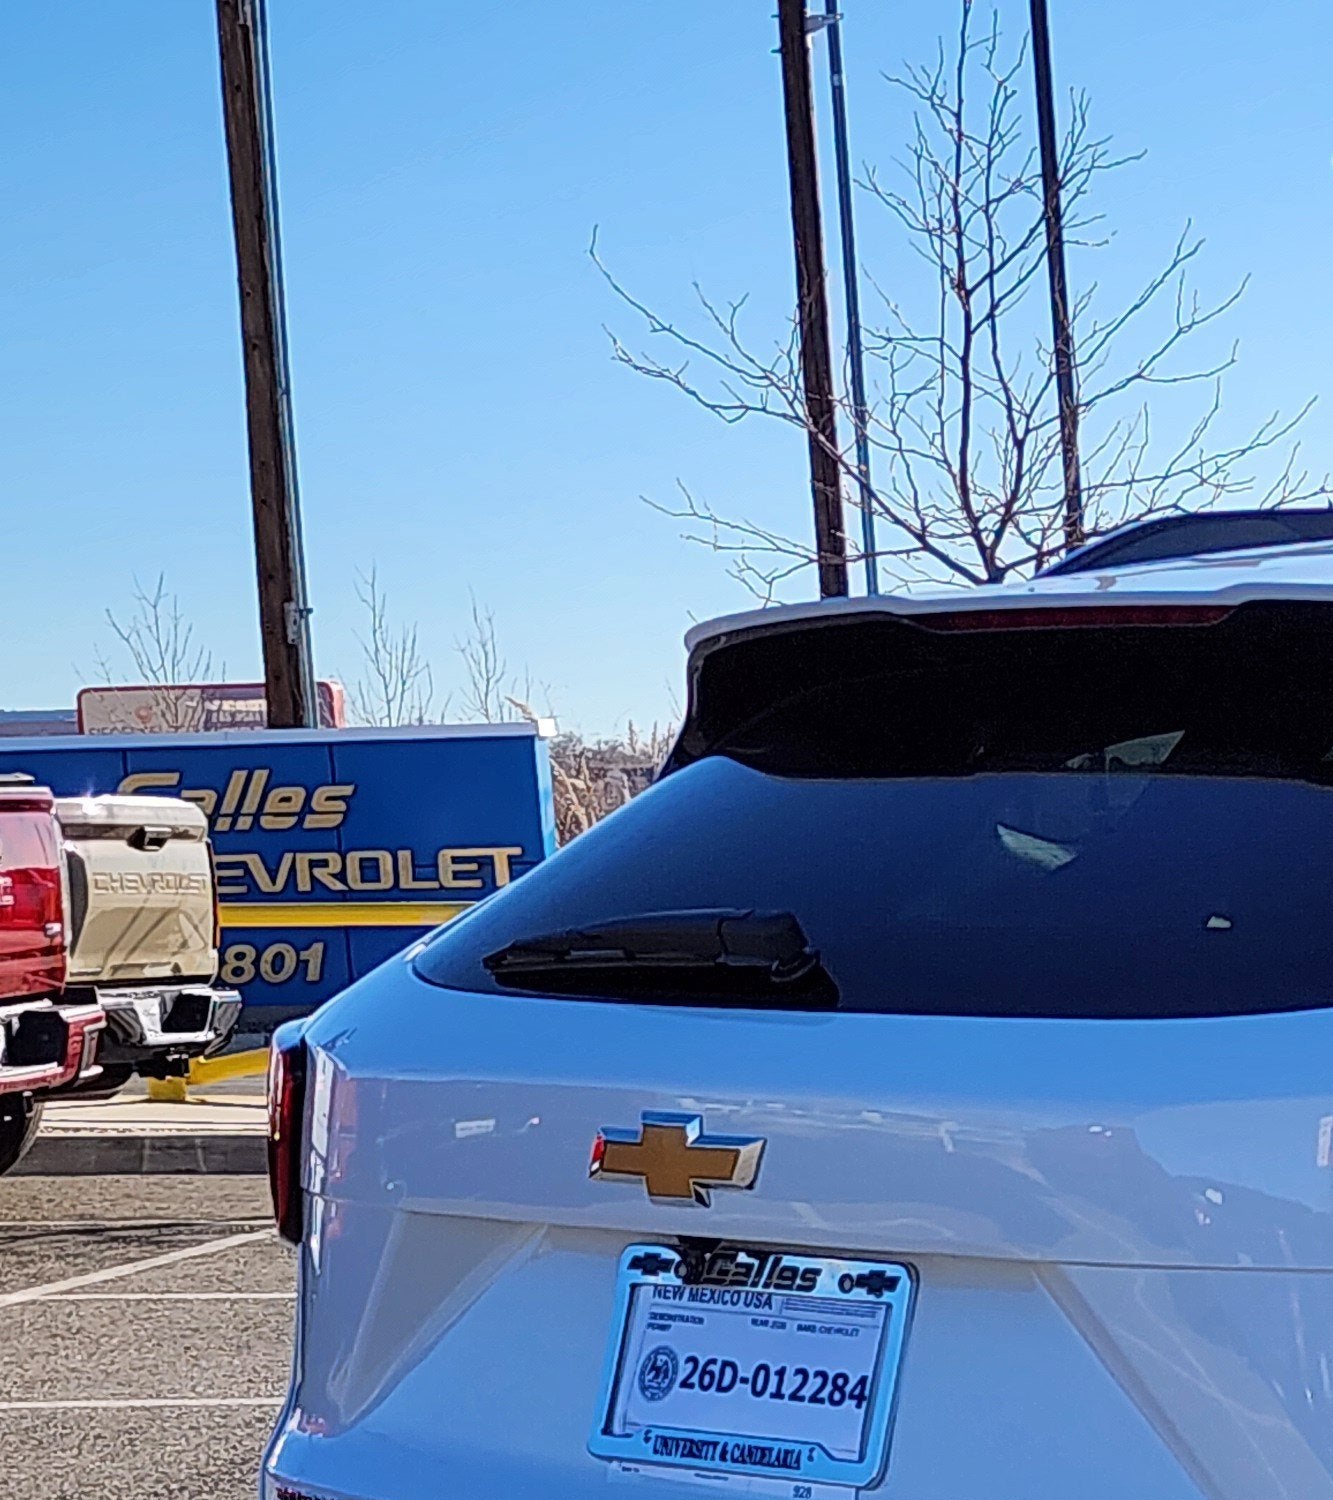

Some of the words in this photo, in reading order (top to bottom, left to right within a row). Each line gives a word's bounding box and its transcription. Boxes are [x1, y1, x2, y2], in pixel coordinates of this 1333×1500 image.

[651, 1285, 686, 1301] NEW
[687, 1287, 741, 1307] MEXICO
[742, 1290, 774, 1310] USA
[678, 1355, 870, 1410] 26D-012284
